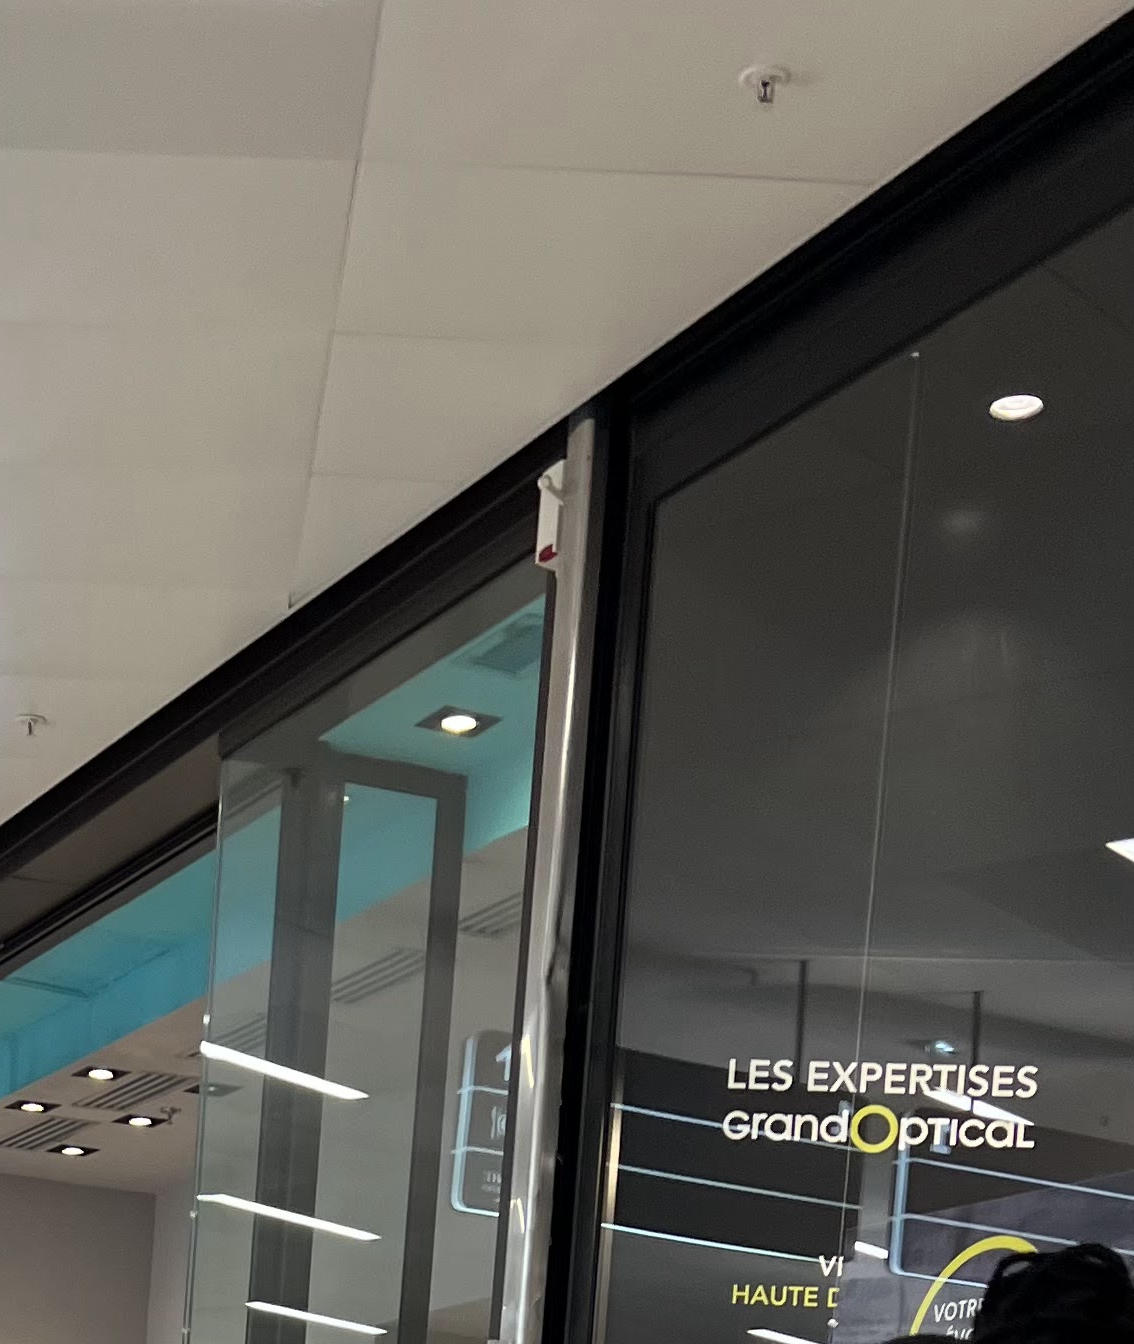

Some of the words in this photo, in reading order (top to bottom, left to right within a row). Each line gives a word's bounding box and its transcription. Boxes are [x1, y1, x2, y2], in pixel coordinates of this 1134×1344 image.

[726, 1057, 794, 1092] LES
[806, 1060, 1039, 1099] EXPERTISES
[731, 1284, 818, 1307] HAUTE
